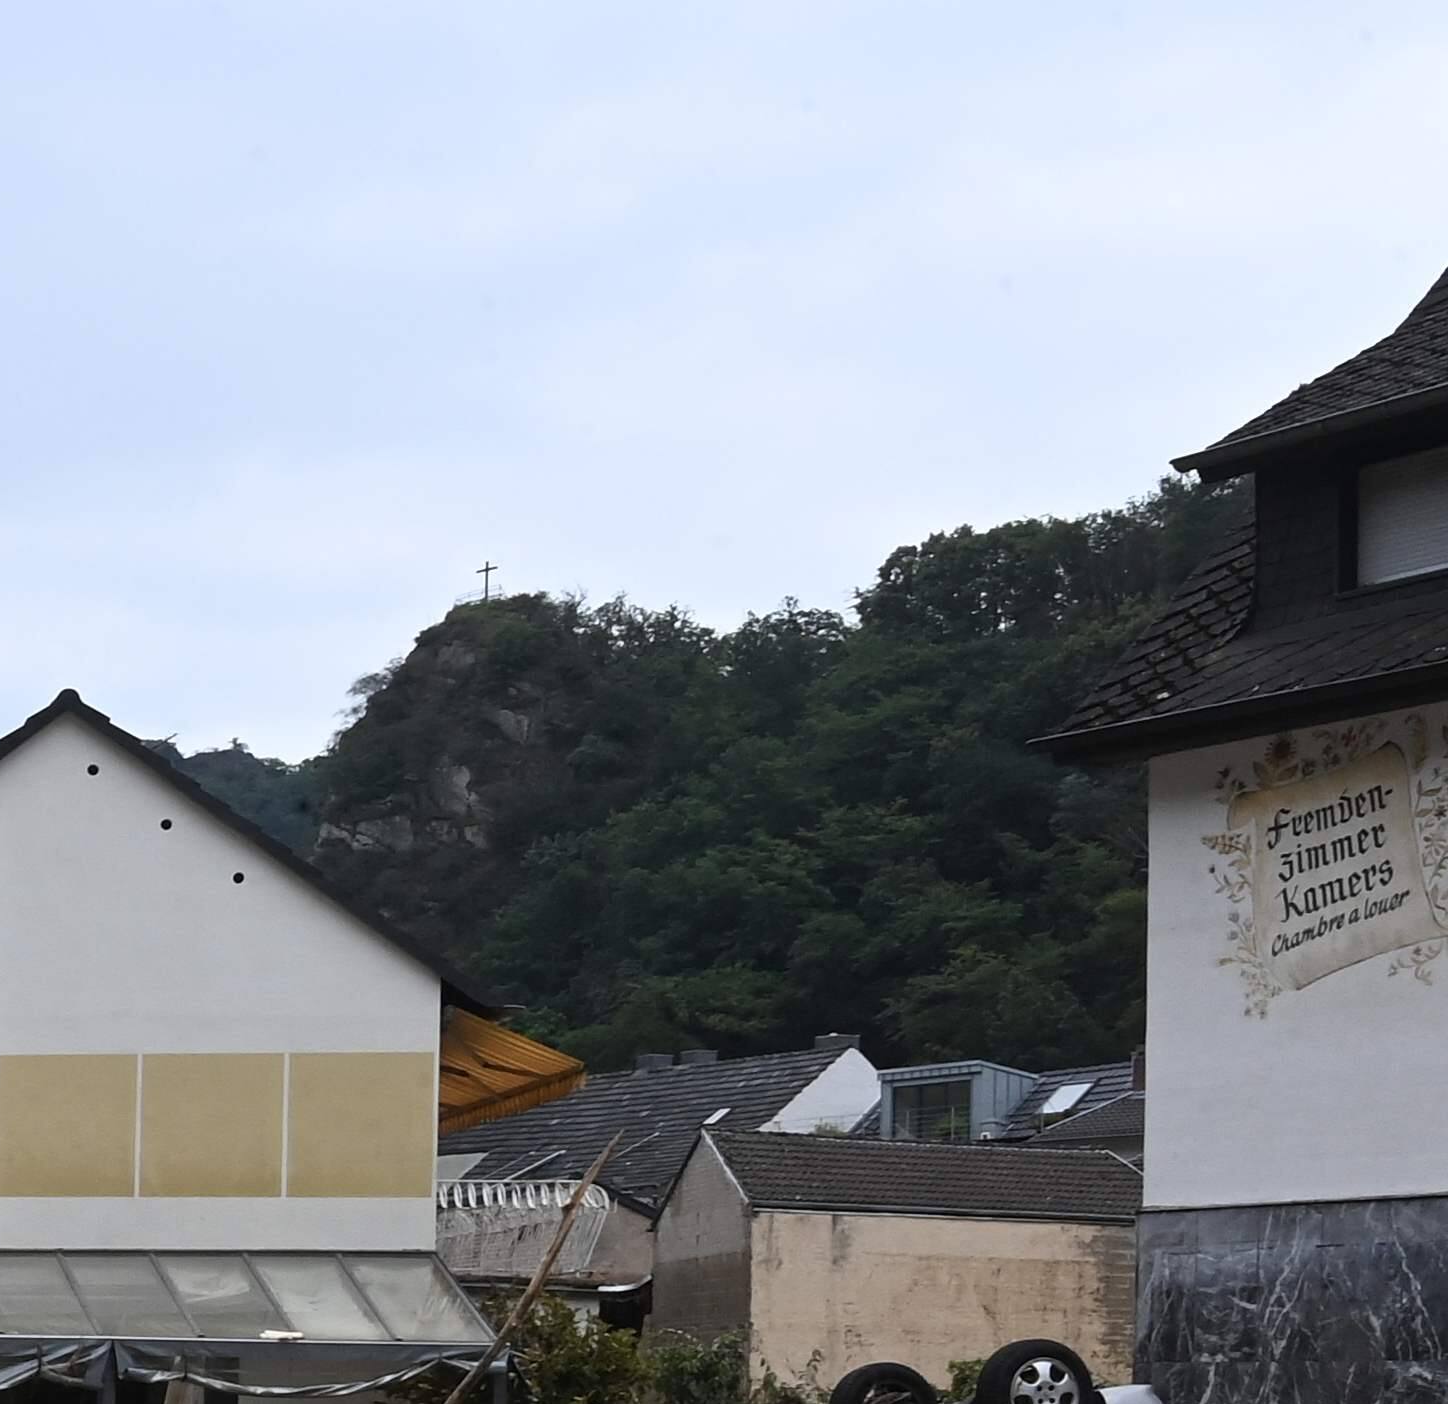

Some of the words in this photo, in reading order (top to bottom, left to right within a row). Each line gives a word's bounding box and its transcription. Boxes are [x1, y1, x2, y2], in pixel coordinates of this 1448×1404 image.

[1272, 912, 1346, 957] Chambre
[1364, 890, 1410, 920] louer
[1276, 859, 1393, 923] Kamers
